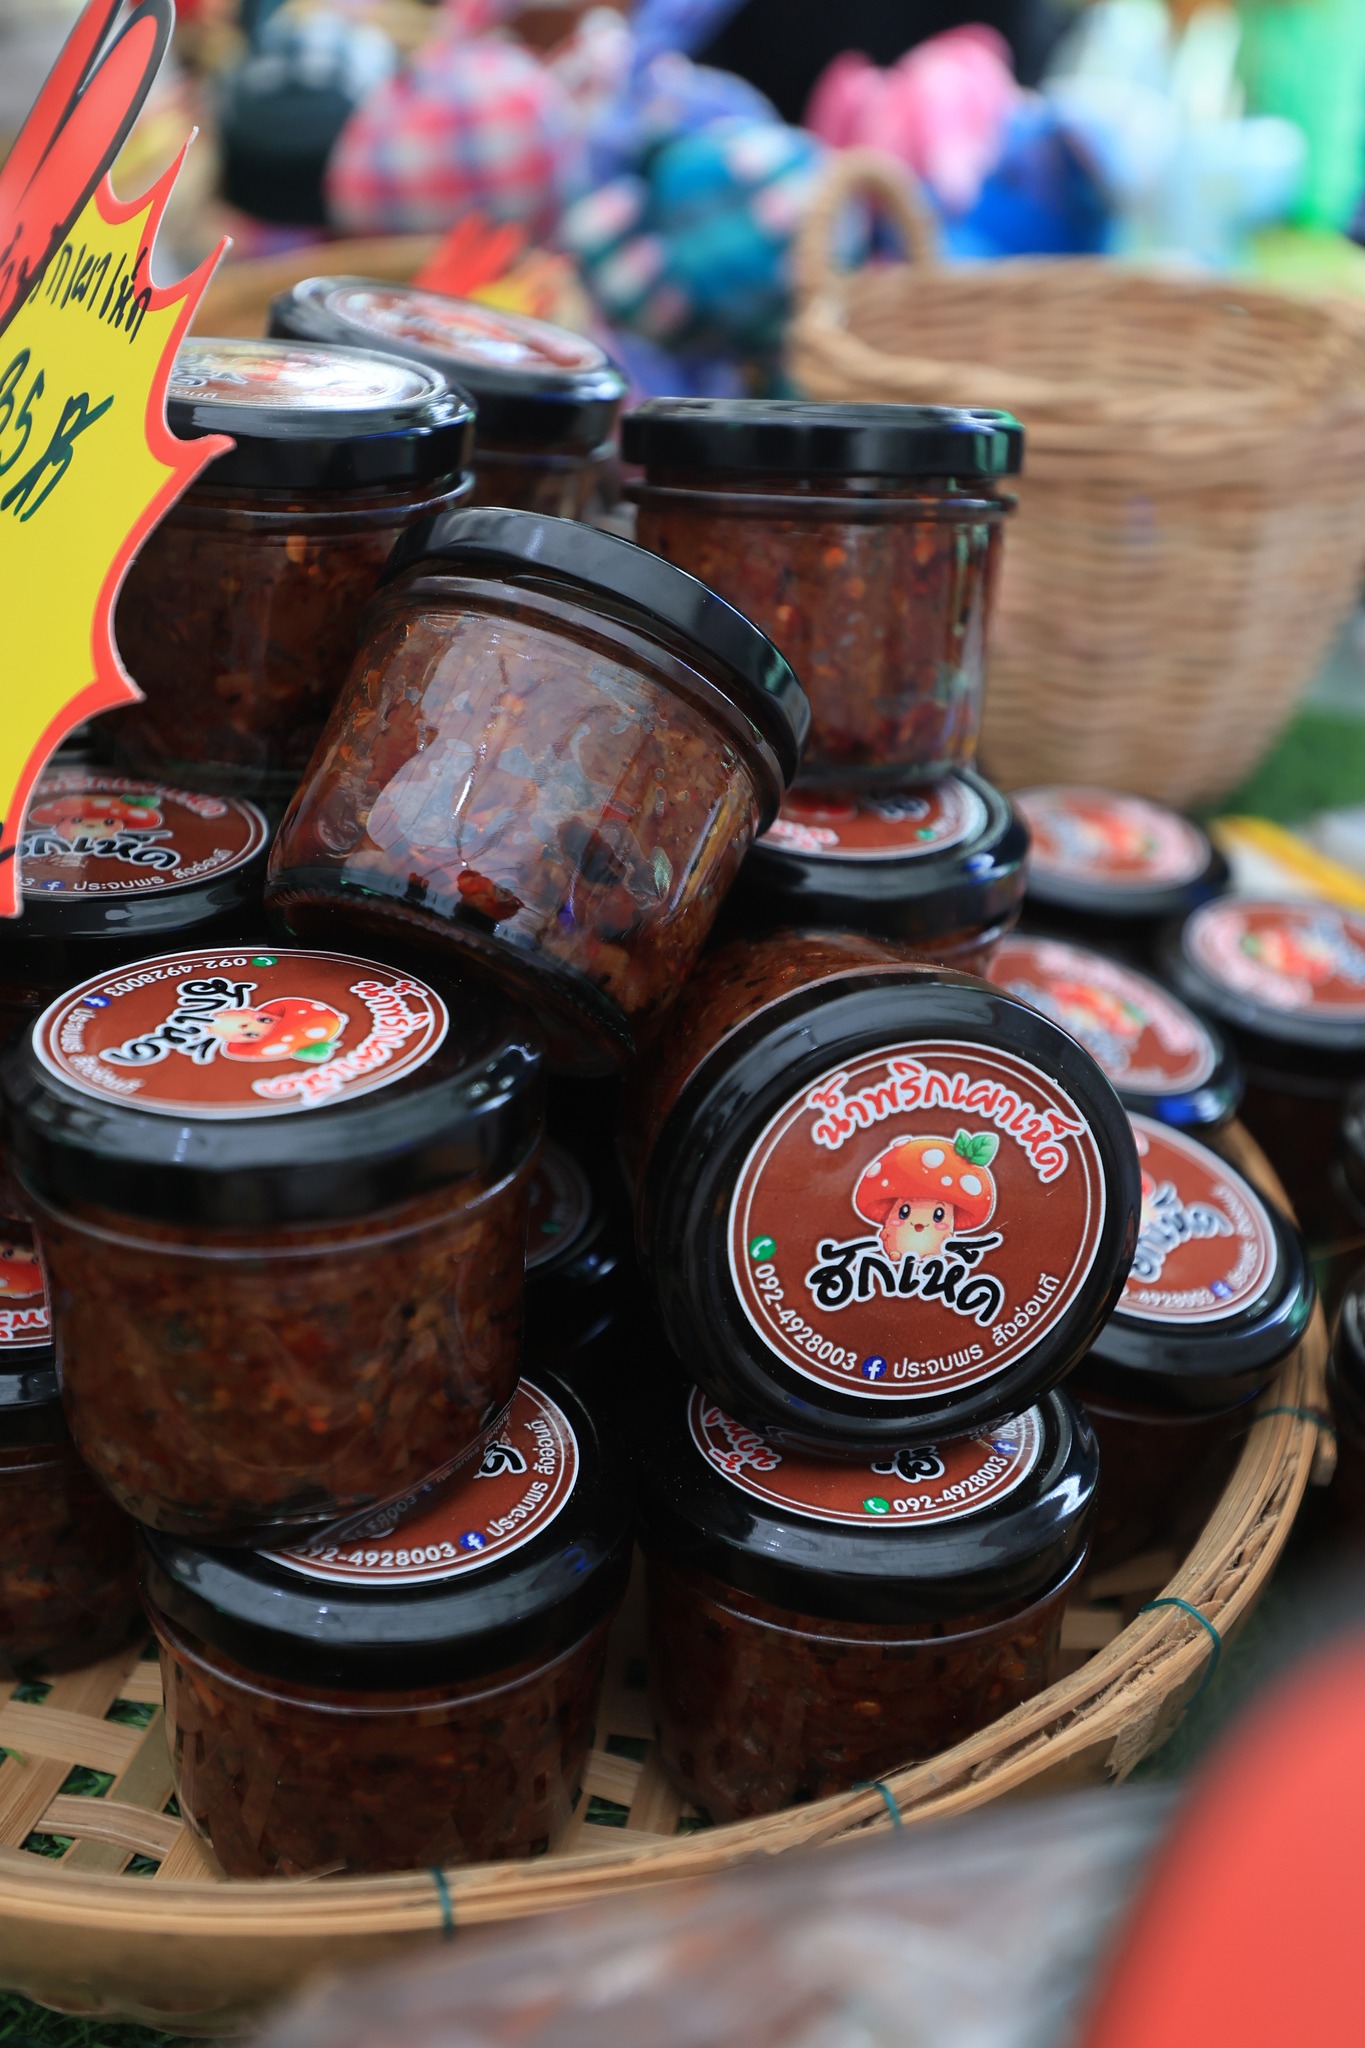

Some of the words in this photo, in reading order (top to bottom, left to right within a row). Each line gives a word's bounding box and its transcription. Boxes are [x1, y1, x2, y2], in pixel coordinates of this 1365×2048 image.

[104, 956, 248, 998] 092-4928003
[808, 1058, 1088, 1183] น้ำพริกเผาเห็ด
[804, 1232, 1003, 1328] ฮักเห็ด
[754, 1263, 858, 1371] 092-4928003
[893, 1343, 984, 1380] ประจบพร
[486, 1480, 549, 1538] ประจบพร
[892, 1454, 1009, 1514] 092-4928003
